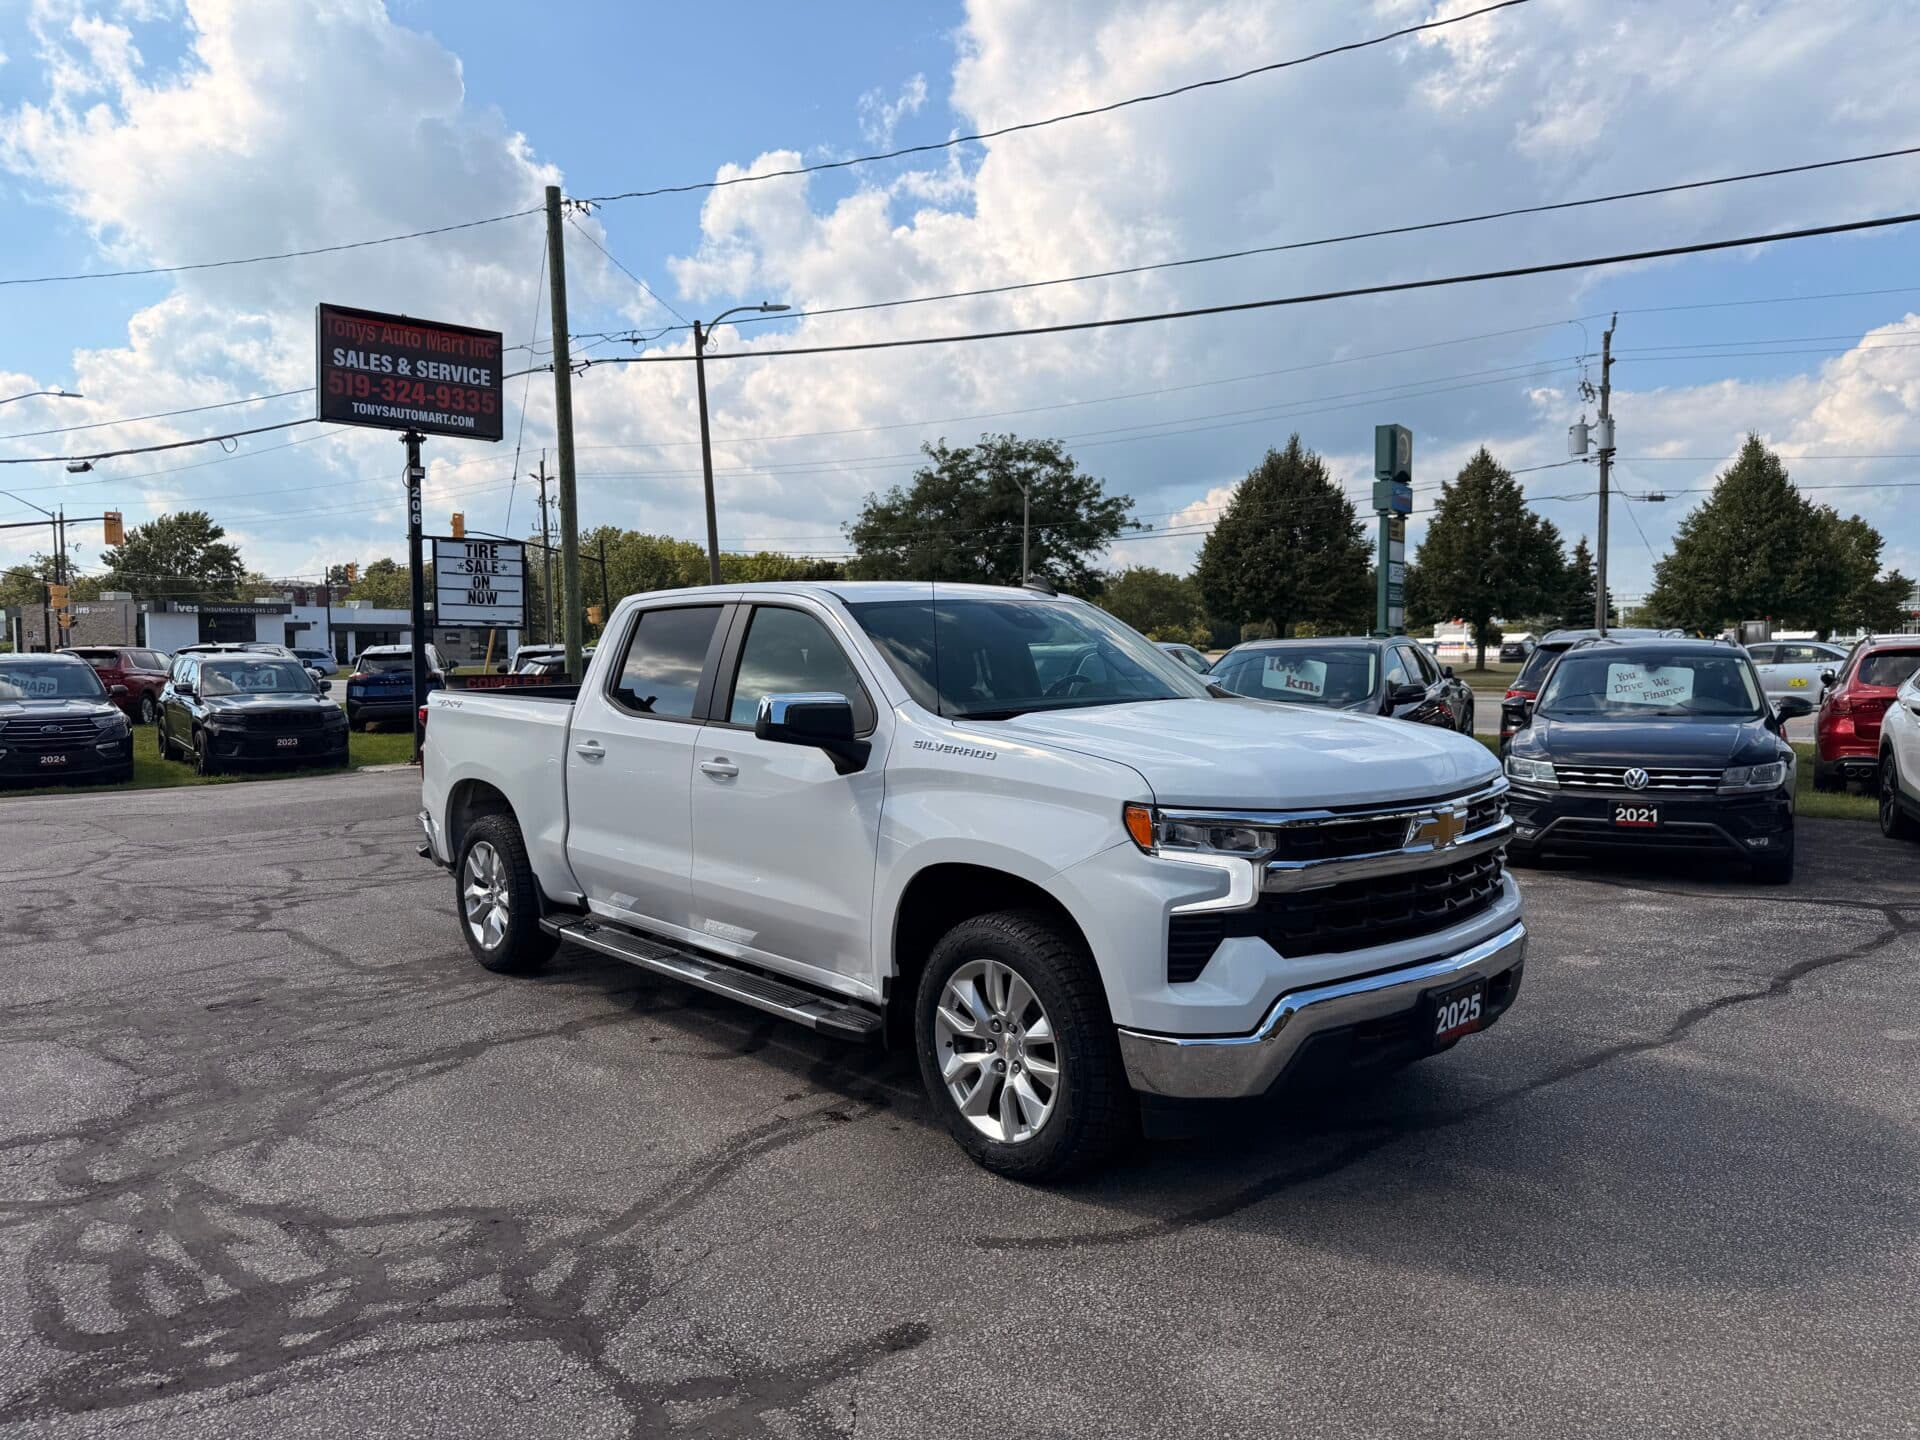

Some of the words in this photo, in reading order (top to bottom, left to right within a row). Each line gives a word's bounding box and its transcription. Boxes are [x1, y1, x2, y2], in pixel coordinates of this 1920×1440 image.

[326, 318, 376, 344] Tonys
[381, 323, 421, 349] Auto
[426, 328, 464, 354] Mart
[333, 347, 393, 374] SALES
[397, 357, 412, 376] &
[416, 360, 491, 387] SERVICE
[327, 372, 496, 414] 519-324-9335
[352, 401, 475, 428] TONYSAUTOMART.COM
[411, 487, 421, 525] 206
[465, 544, 499, 559] TIRE
[472, 576, 490, 590] ON
[468, 591, 498, 605] NOW
[174, 601, 199, 613] ives
[1285, 674, 1320, 693] kms
[1616, 671, 1636, 682] You
[1652, 677, 1670, 687] We
[1614, 681, 1644, 694] Drive
[1643, 685, 1685, 701] Finance
[277, 738, 298, 747] 2023
[912, 740, 998, 760] SILVERADO
[40, 755, 66, 764] 2024
[1615, 807, 1658, 823] 2021
[1436, 993, 1481, 1034] 2025
